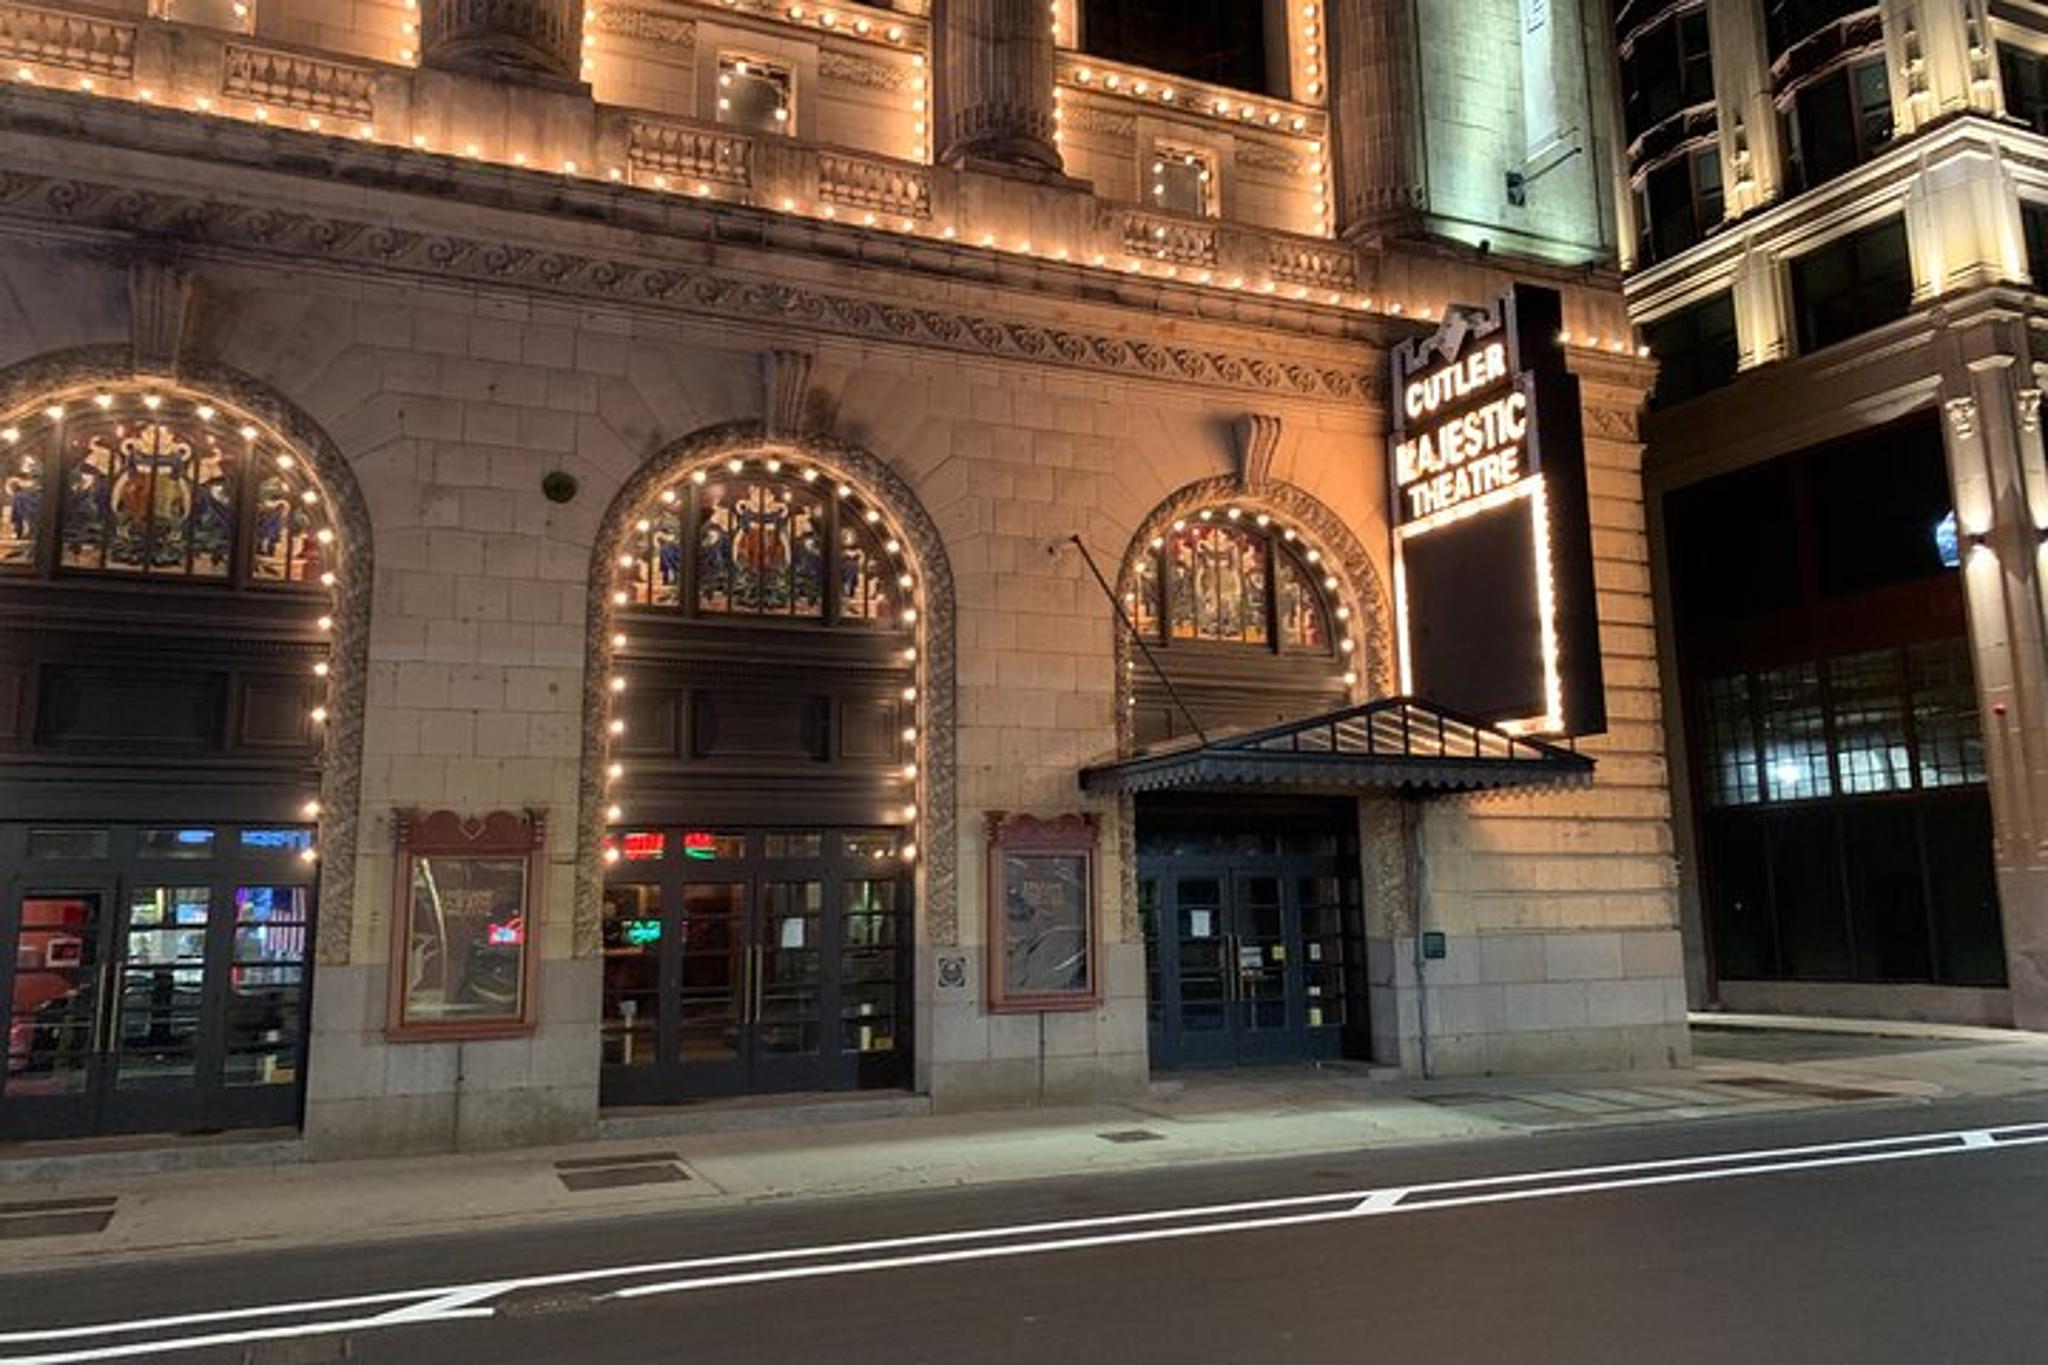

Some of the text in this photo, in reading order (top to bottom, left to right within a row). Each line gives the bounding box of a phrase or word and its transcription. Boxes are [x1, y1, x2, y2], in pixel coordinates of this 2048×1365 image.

[1405, 343, 1506, 418] CUTLER
[1396, 392, 1526, 486] MAJESTIC
[1408, 447, 1519, 518] THEATRE
